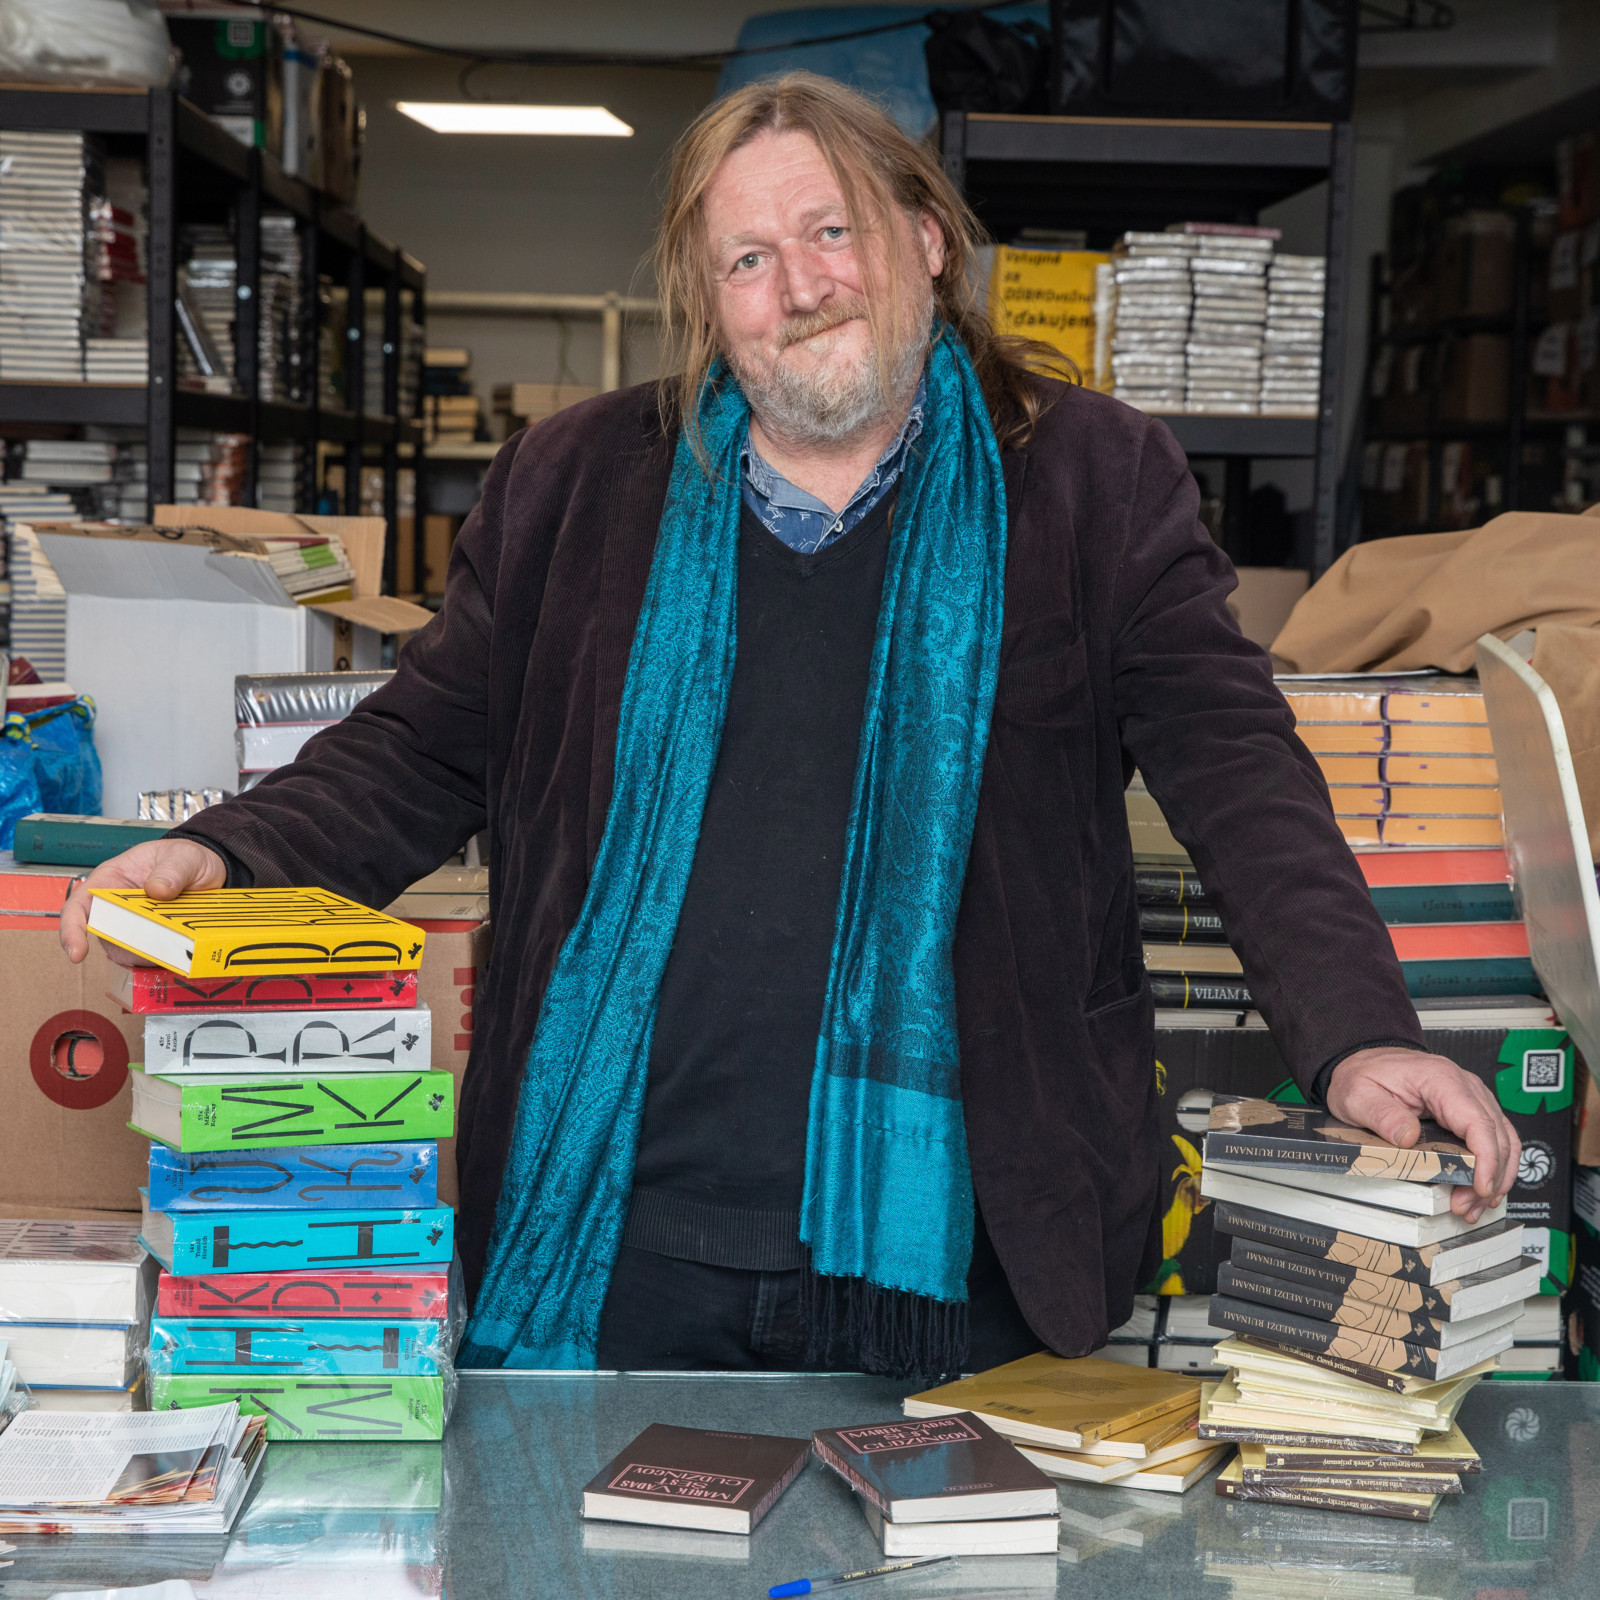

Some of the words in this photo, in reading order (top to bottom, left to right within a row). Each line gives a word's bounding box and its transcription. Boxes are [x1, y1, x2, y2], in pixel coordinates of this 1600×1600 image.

[1194, 987, 1239, 1000] VILIAM
[1225, 1144, 1274, 1158] RUINAMI
[1275, 1149, 1312, 1161] MEDZI
[1315, 1151, 1349, 1164] BALLA
[1228, 1215, 1267, 1232] RUINAMI
[1269, 1227, 1297, 1240] MEDZI
[1299, 1234, 1327, 1248] BALLA
[1246, 1251, 1286, 1269] RUINAMI
[1288, 1263, 1316, 1277] MEDZI
[1318, 1270, 1346, 1285] BALLA
[1231, 1278, 1271, 1295] RUINAMI
[1274, 1289, 1303, 1304] MEDZI
[1305, 1297, 1334, 1312] BALLA
[1223, 1310, 1265, 1327] RUINAMI
[1267, 1321, 1297, 1335] MEDZI
[1299, 1328, 1327, 1343] BALLA
[848, 1426, 900, 1439] MAREK
[902, 1420, 956, 1432] VADAS
[1353, 1458, 1375, 1469] Človek
[620, 1479, 672, 1494] VADAS
[1330, 1476, 1352, 1487] Človek
[676, 1486, 732, 1501] MAREK
